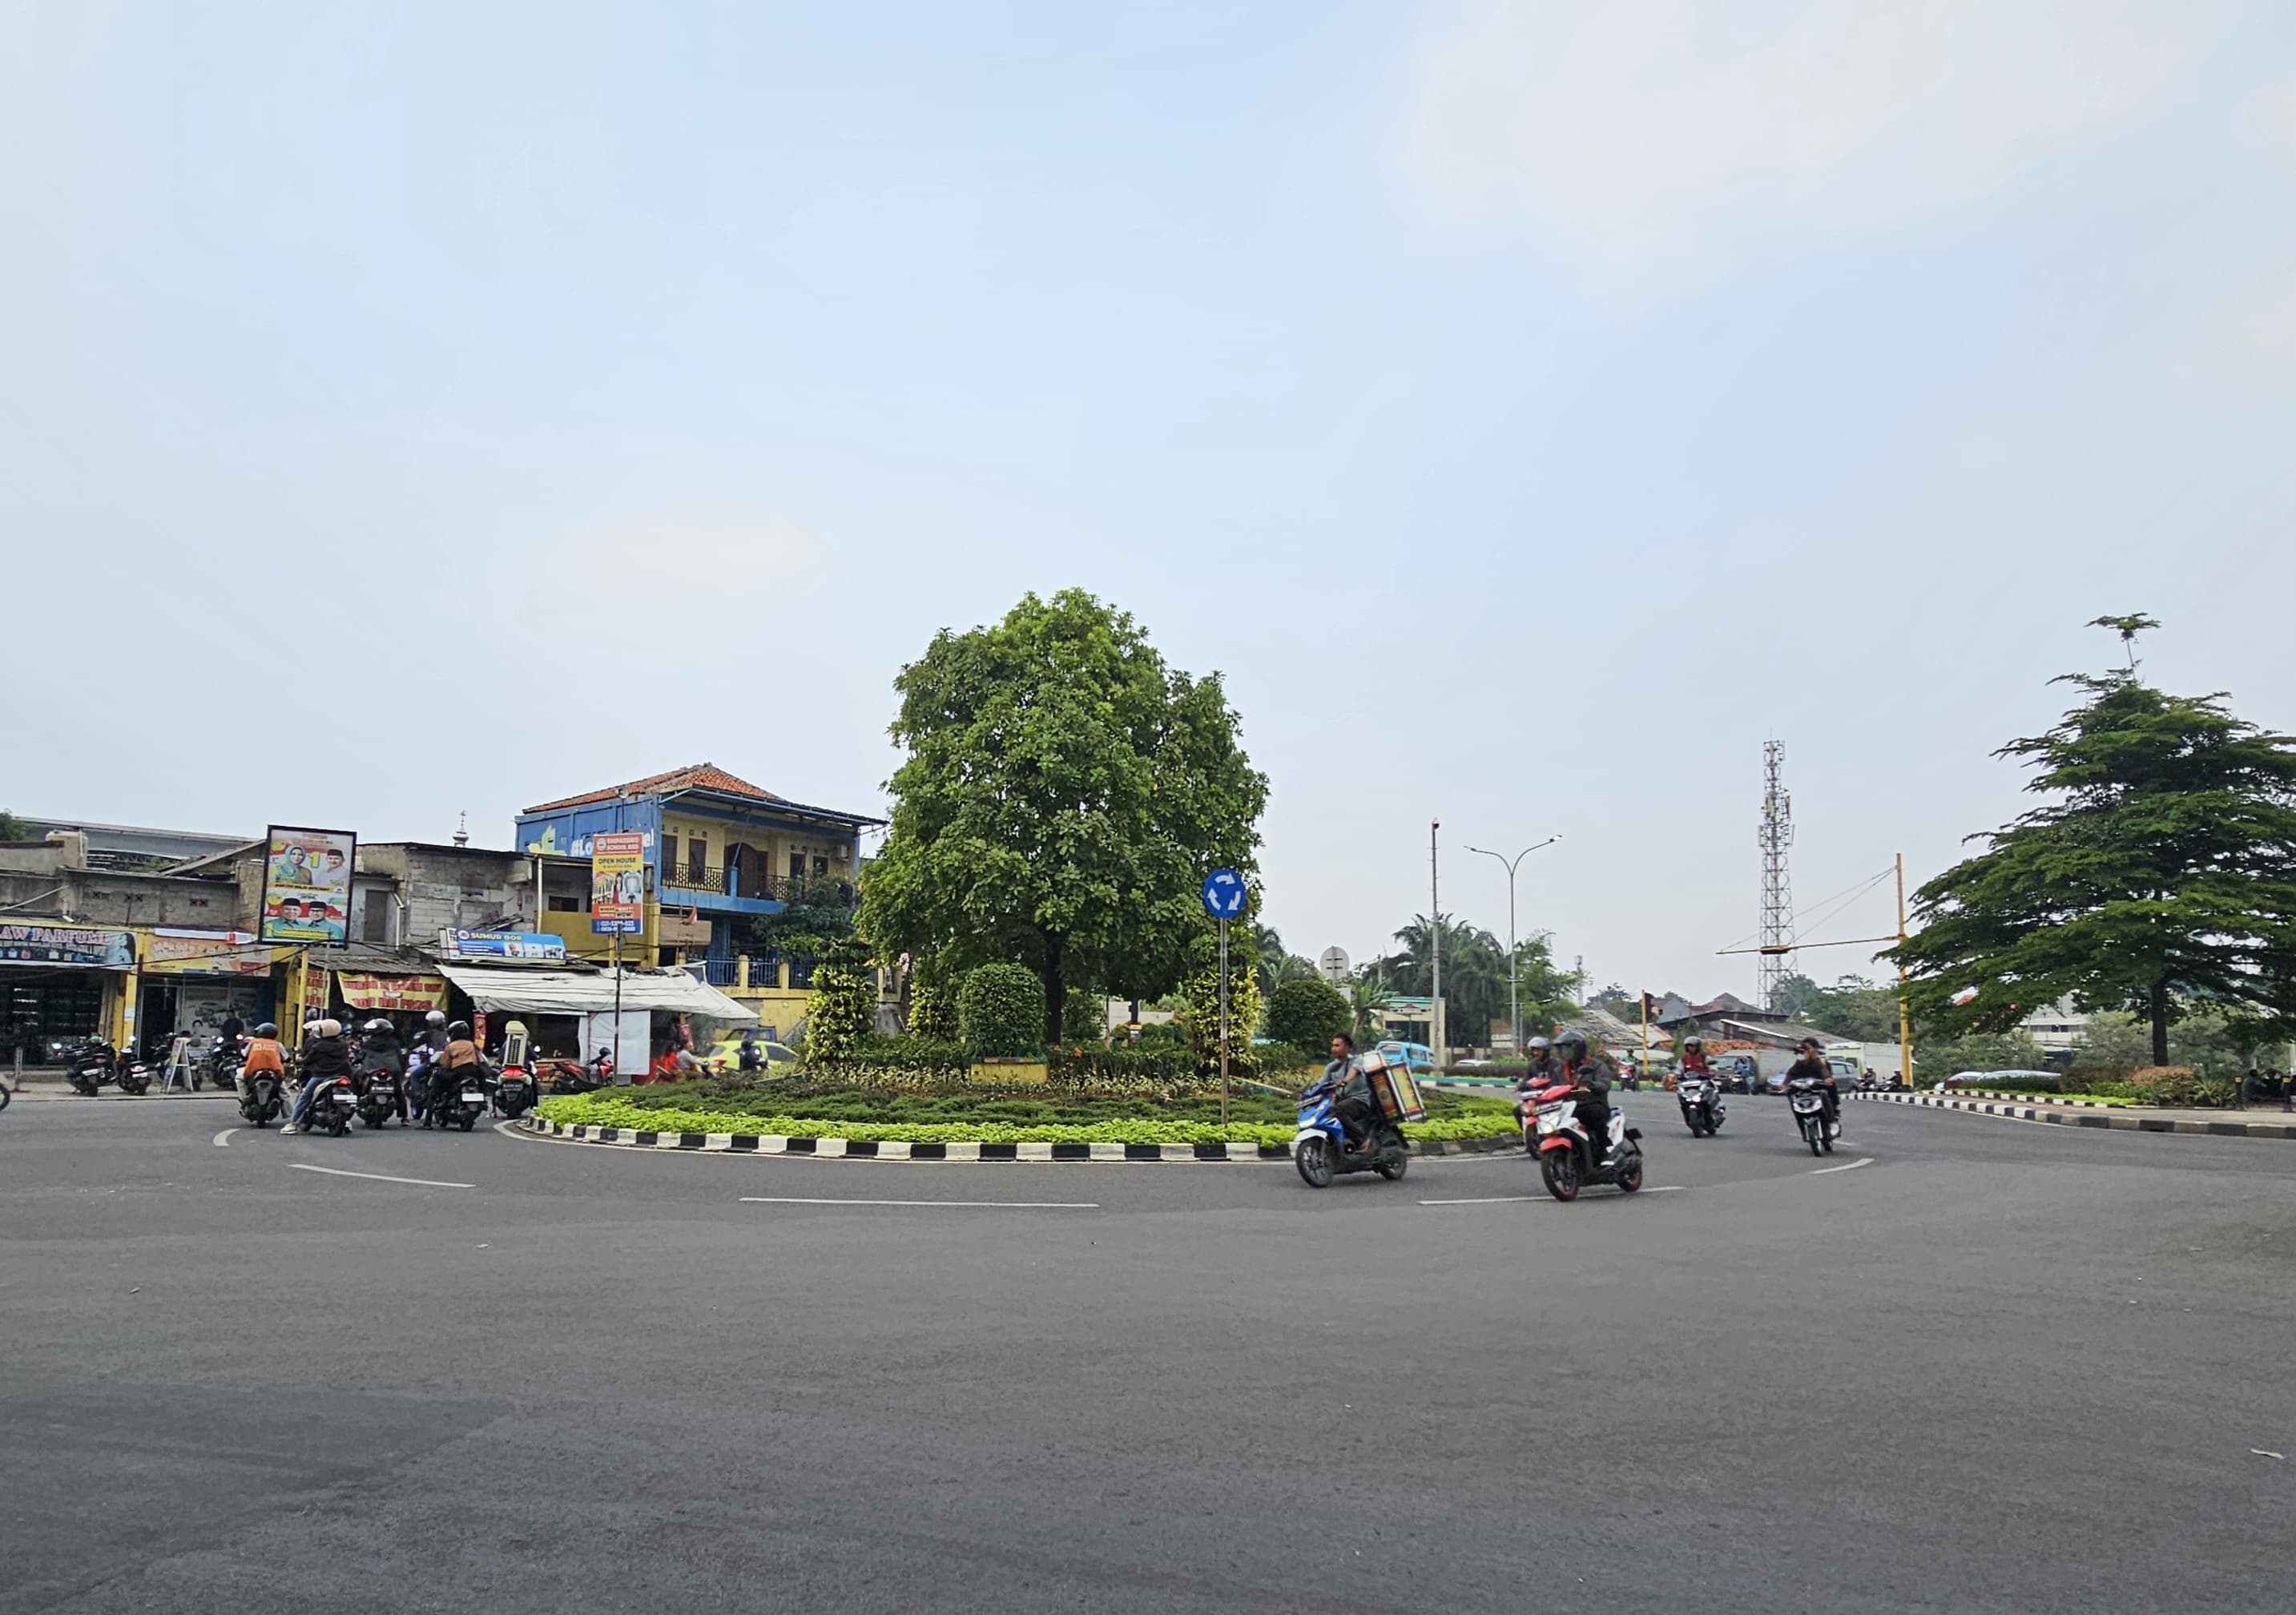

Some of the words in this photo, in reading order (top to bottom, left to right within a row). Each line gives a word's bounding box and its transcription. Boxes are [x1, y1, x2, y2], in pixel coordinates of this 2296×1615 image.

[308, 852, 320, 868] 1
[31, 927, 111, 945] PARFUME
[471, 932, 502, 940] SUMUR
